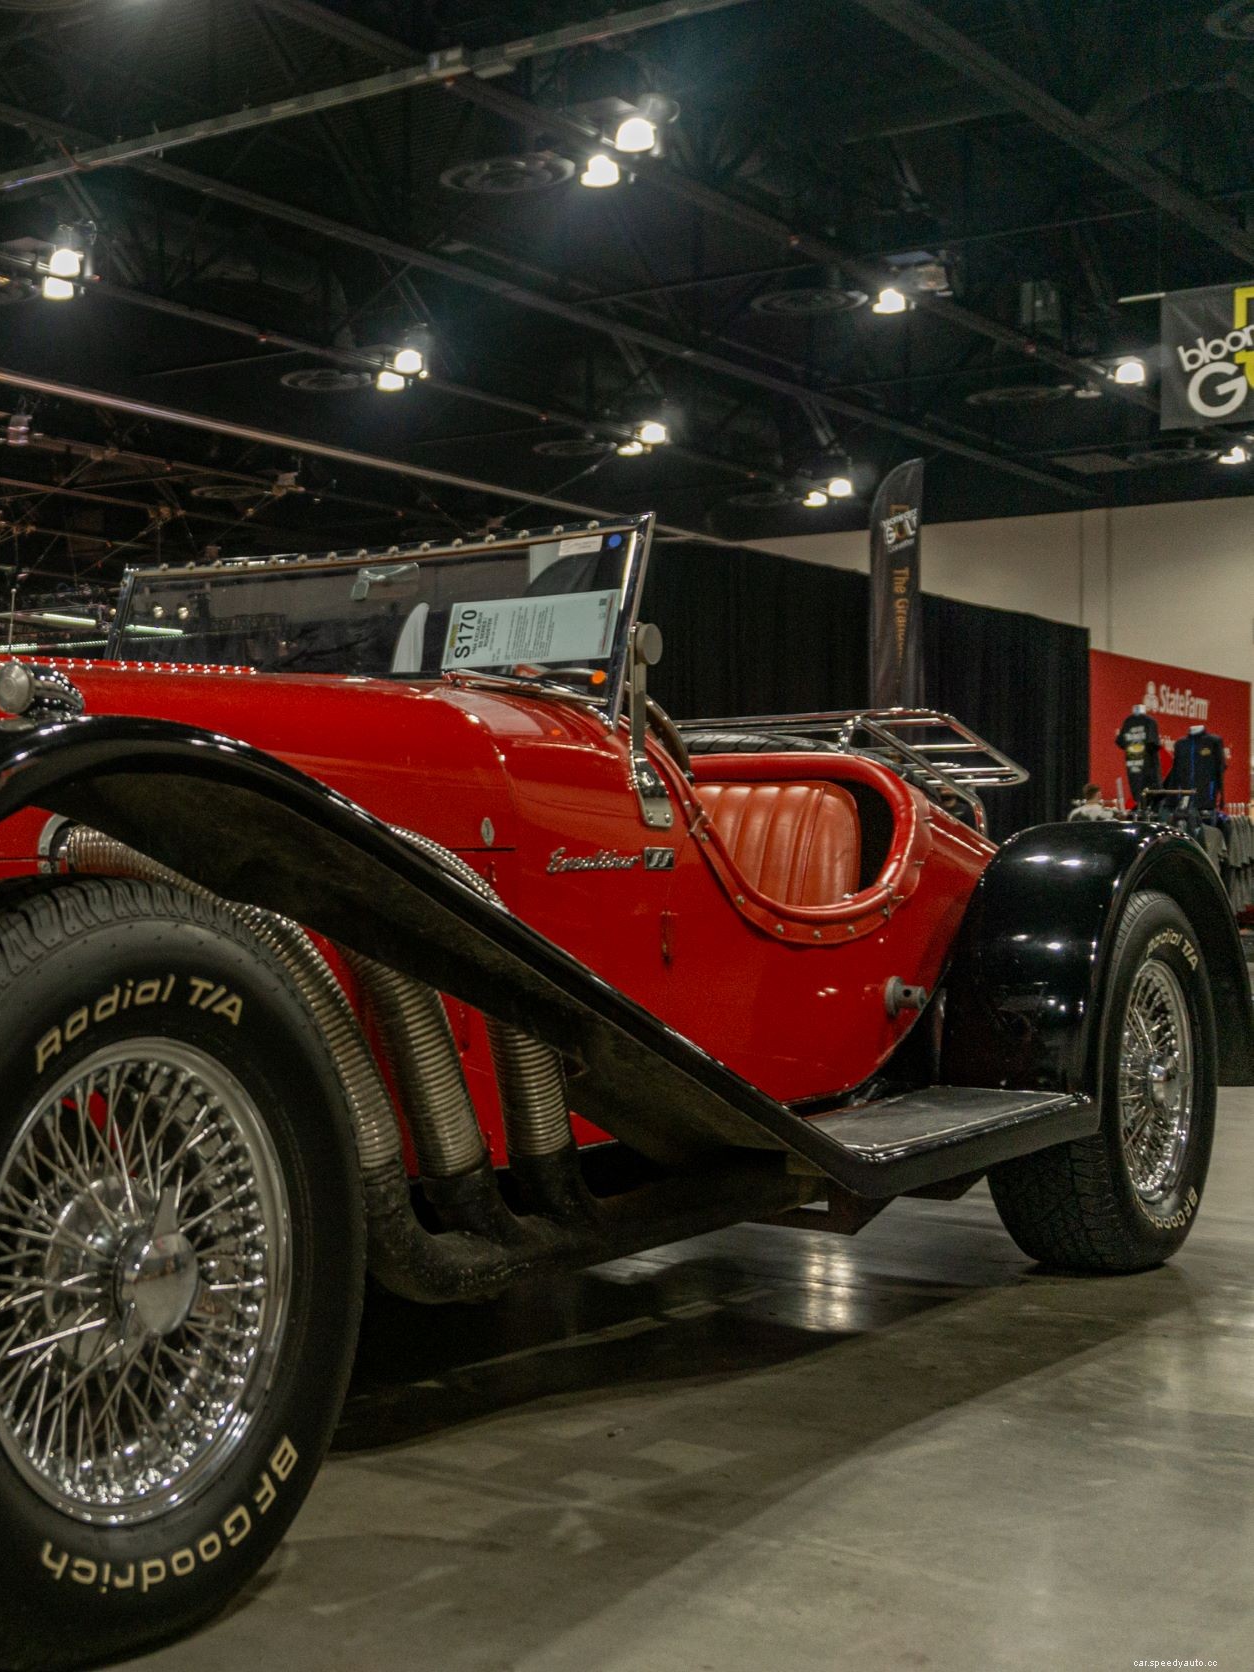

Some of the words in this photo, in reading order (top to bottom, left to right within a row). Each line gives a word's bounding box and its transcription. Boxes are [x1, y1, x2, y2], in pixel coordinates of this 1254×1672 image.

[454, 610, 477, 659] S170
[34, 973, 176, 1074] Radial
[189, 976, 243, 1026] T/A
[41, 1435, 298, 1593] BFGoodrich
